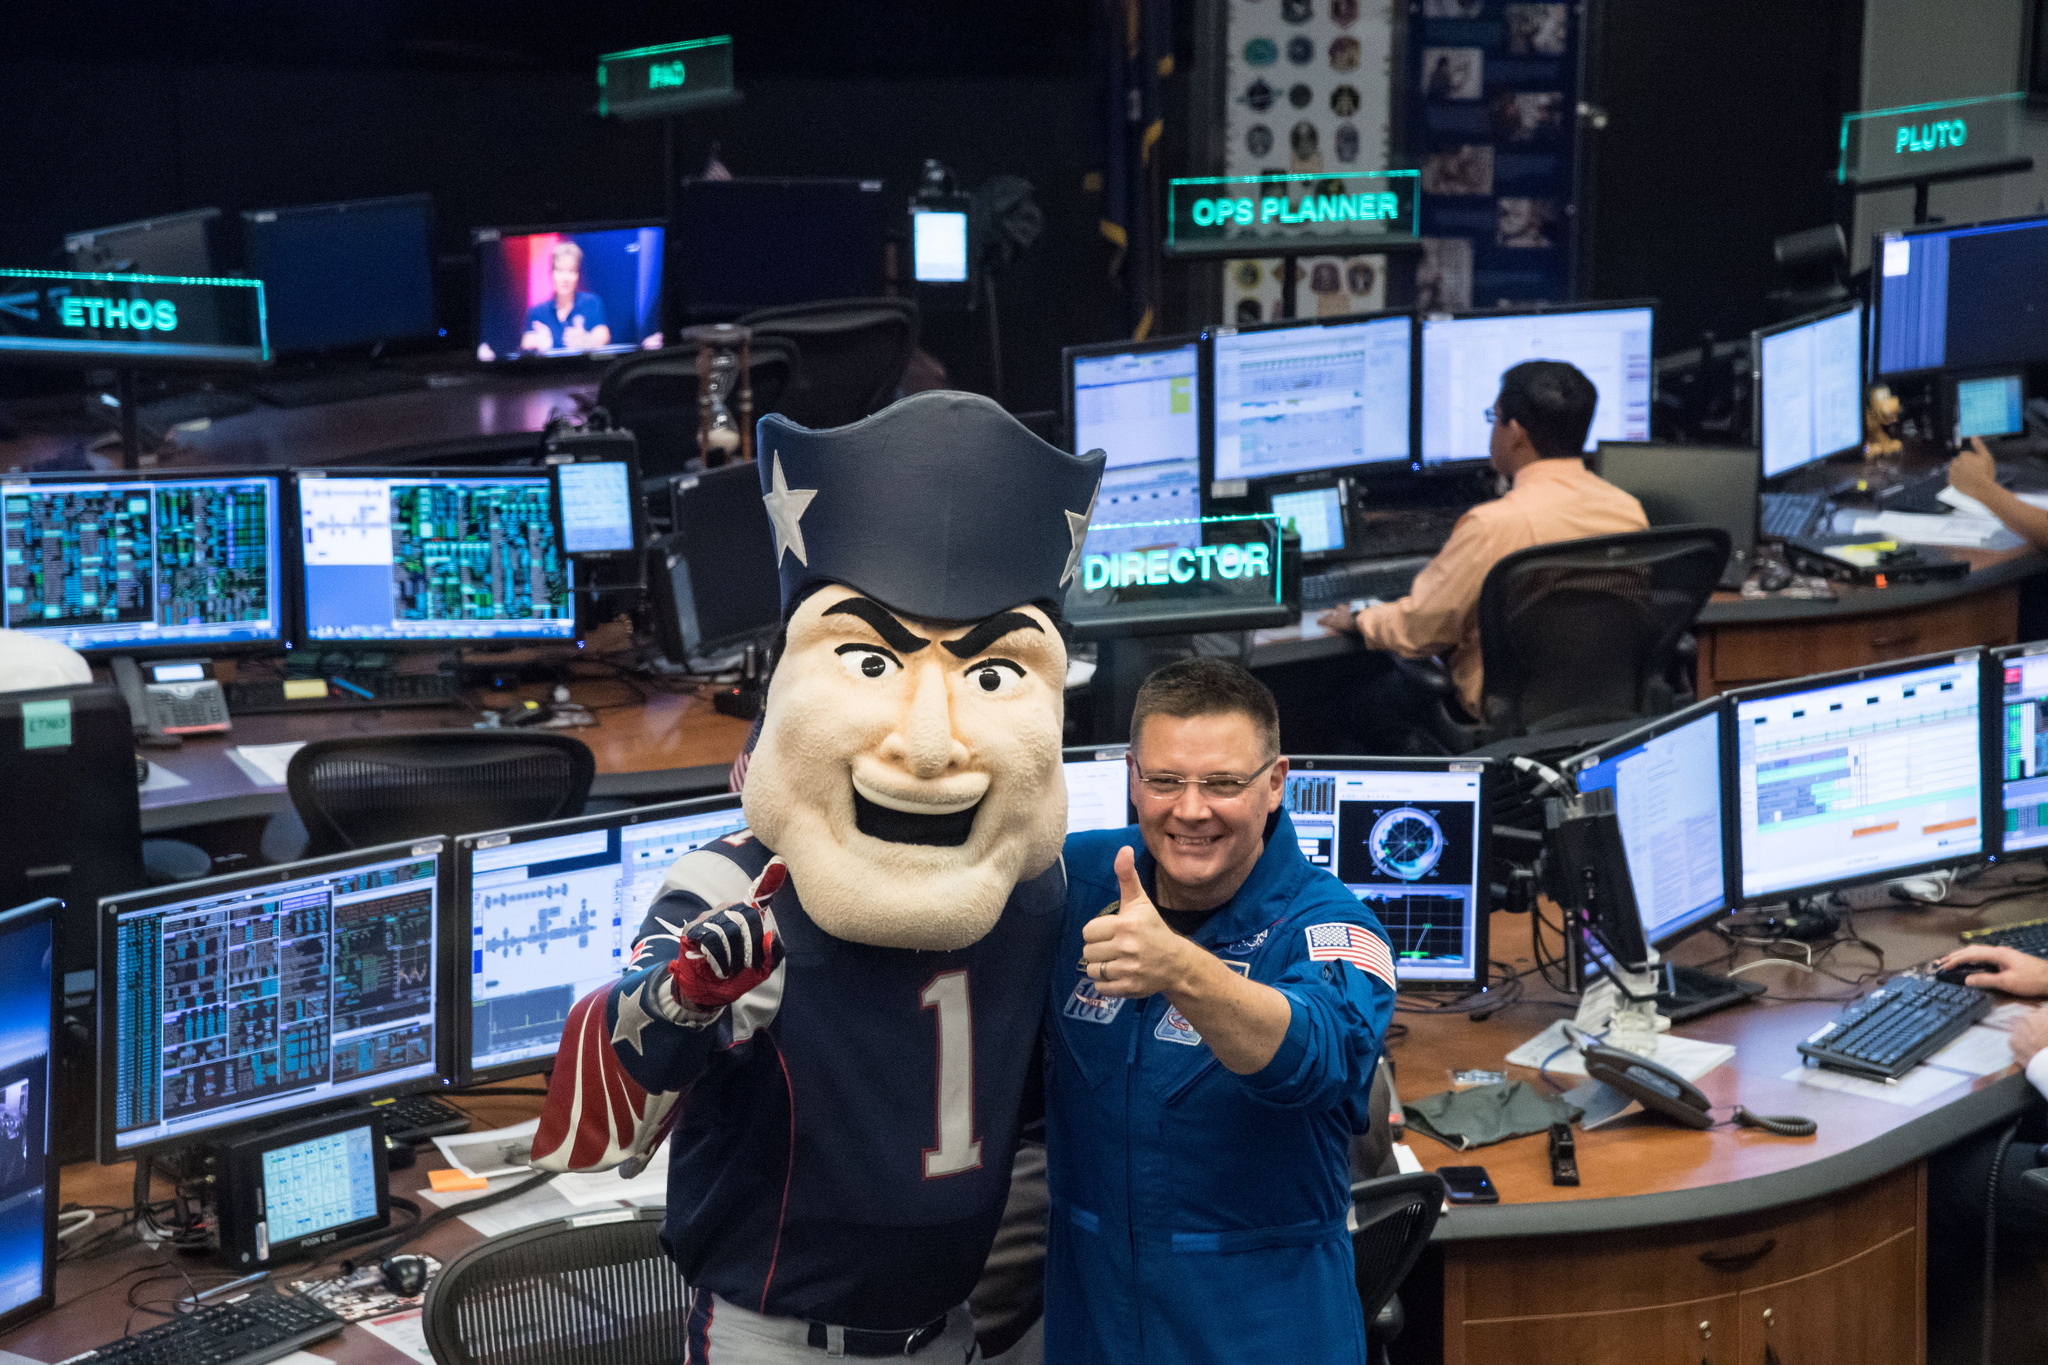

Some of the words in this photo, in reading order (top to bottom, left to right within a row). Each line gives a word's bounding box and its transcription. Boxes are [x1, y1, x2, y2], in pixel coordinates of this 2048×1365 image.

[1896, 119, 1967, 154] PLUTO
[1192, 198, 1254, 226] OPS
[1261, 191, 1398, 224] PLANNER
[62, 296, 178, 331] ETHOS
[1084, 542, 1269, 590] DIRECTOR
[920, 970, 982, 1181] 1
